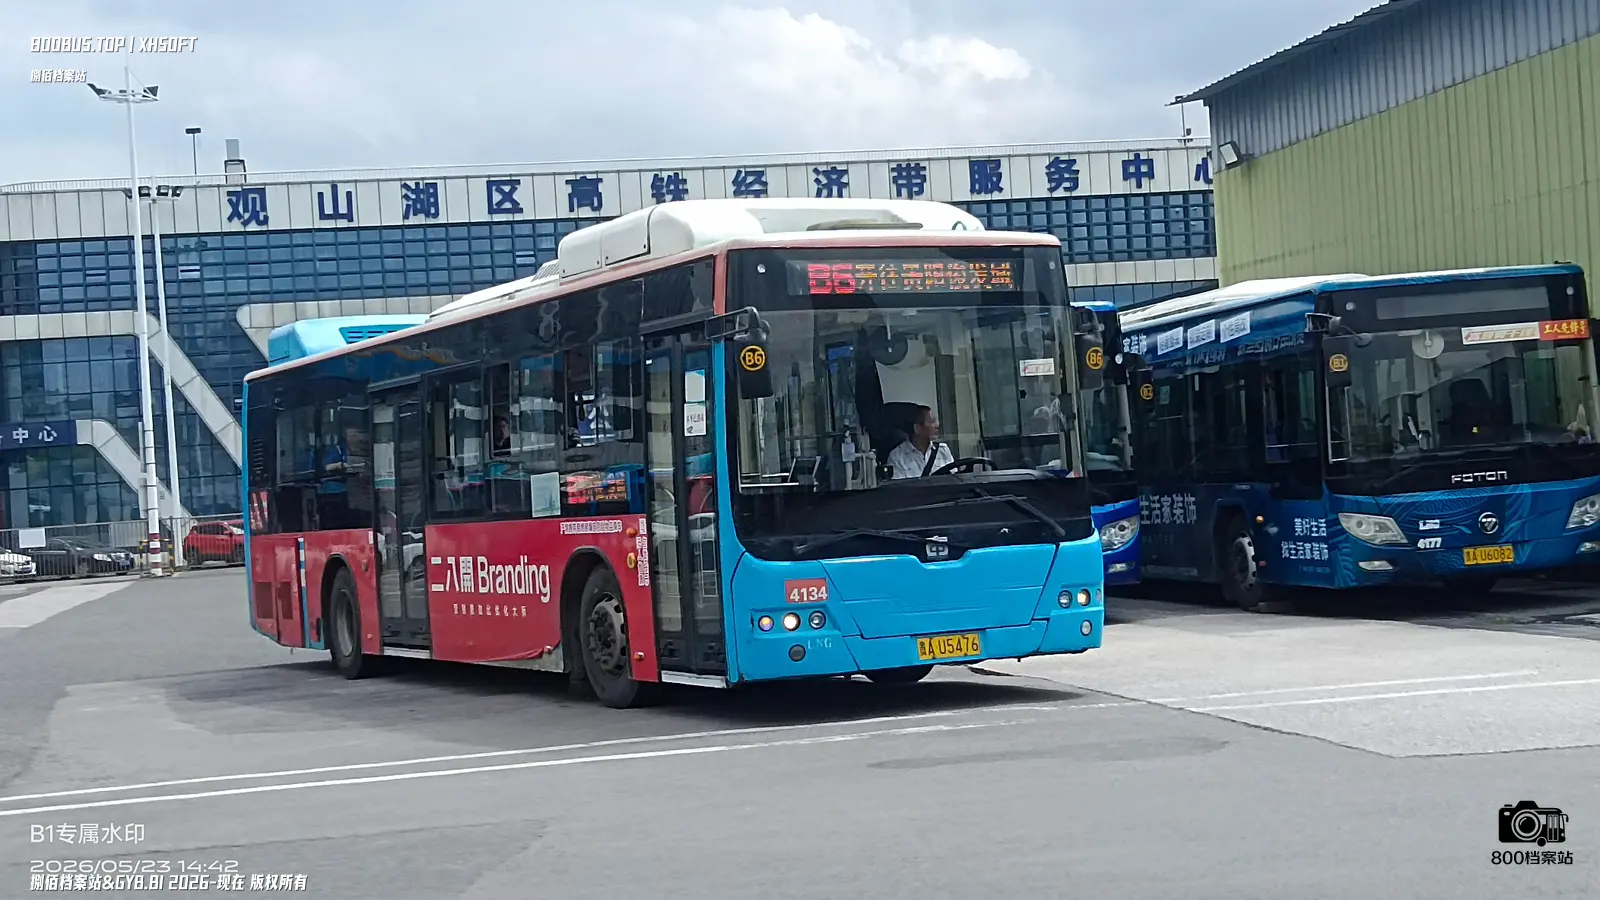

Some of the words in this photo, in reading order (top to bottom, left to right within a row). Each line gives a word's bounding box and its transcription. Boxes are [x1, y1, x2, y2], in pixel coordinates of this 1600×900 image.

[745, 351, 762, 365] B6
[0, 425, 57, 444] 中心
[1451, 470, 1508, 484] FOTON
[1294, 518, 1328, 537] 美好生活
[477, 555, 550, 603] Branding
[789, 585, 828, 602] 4134
[806, 637, 832, 650] LNG
